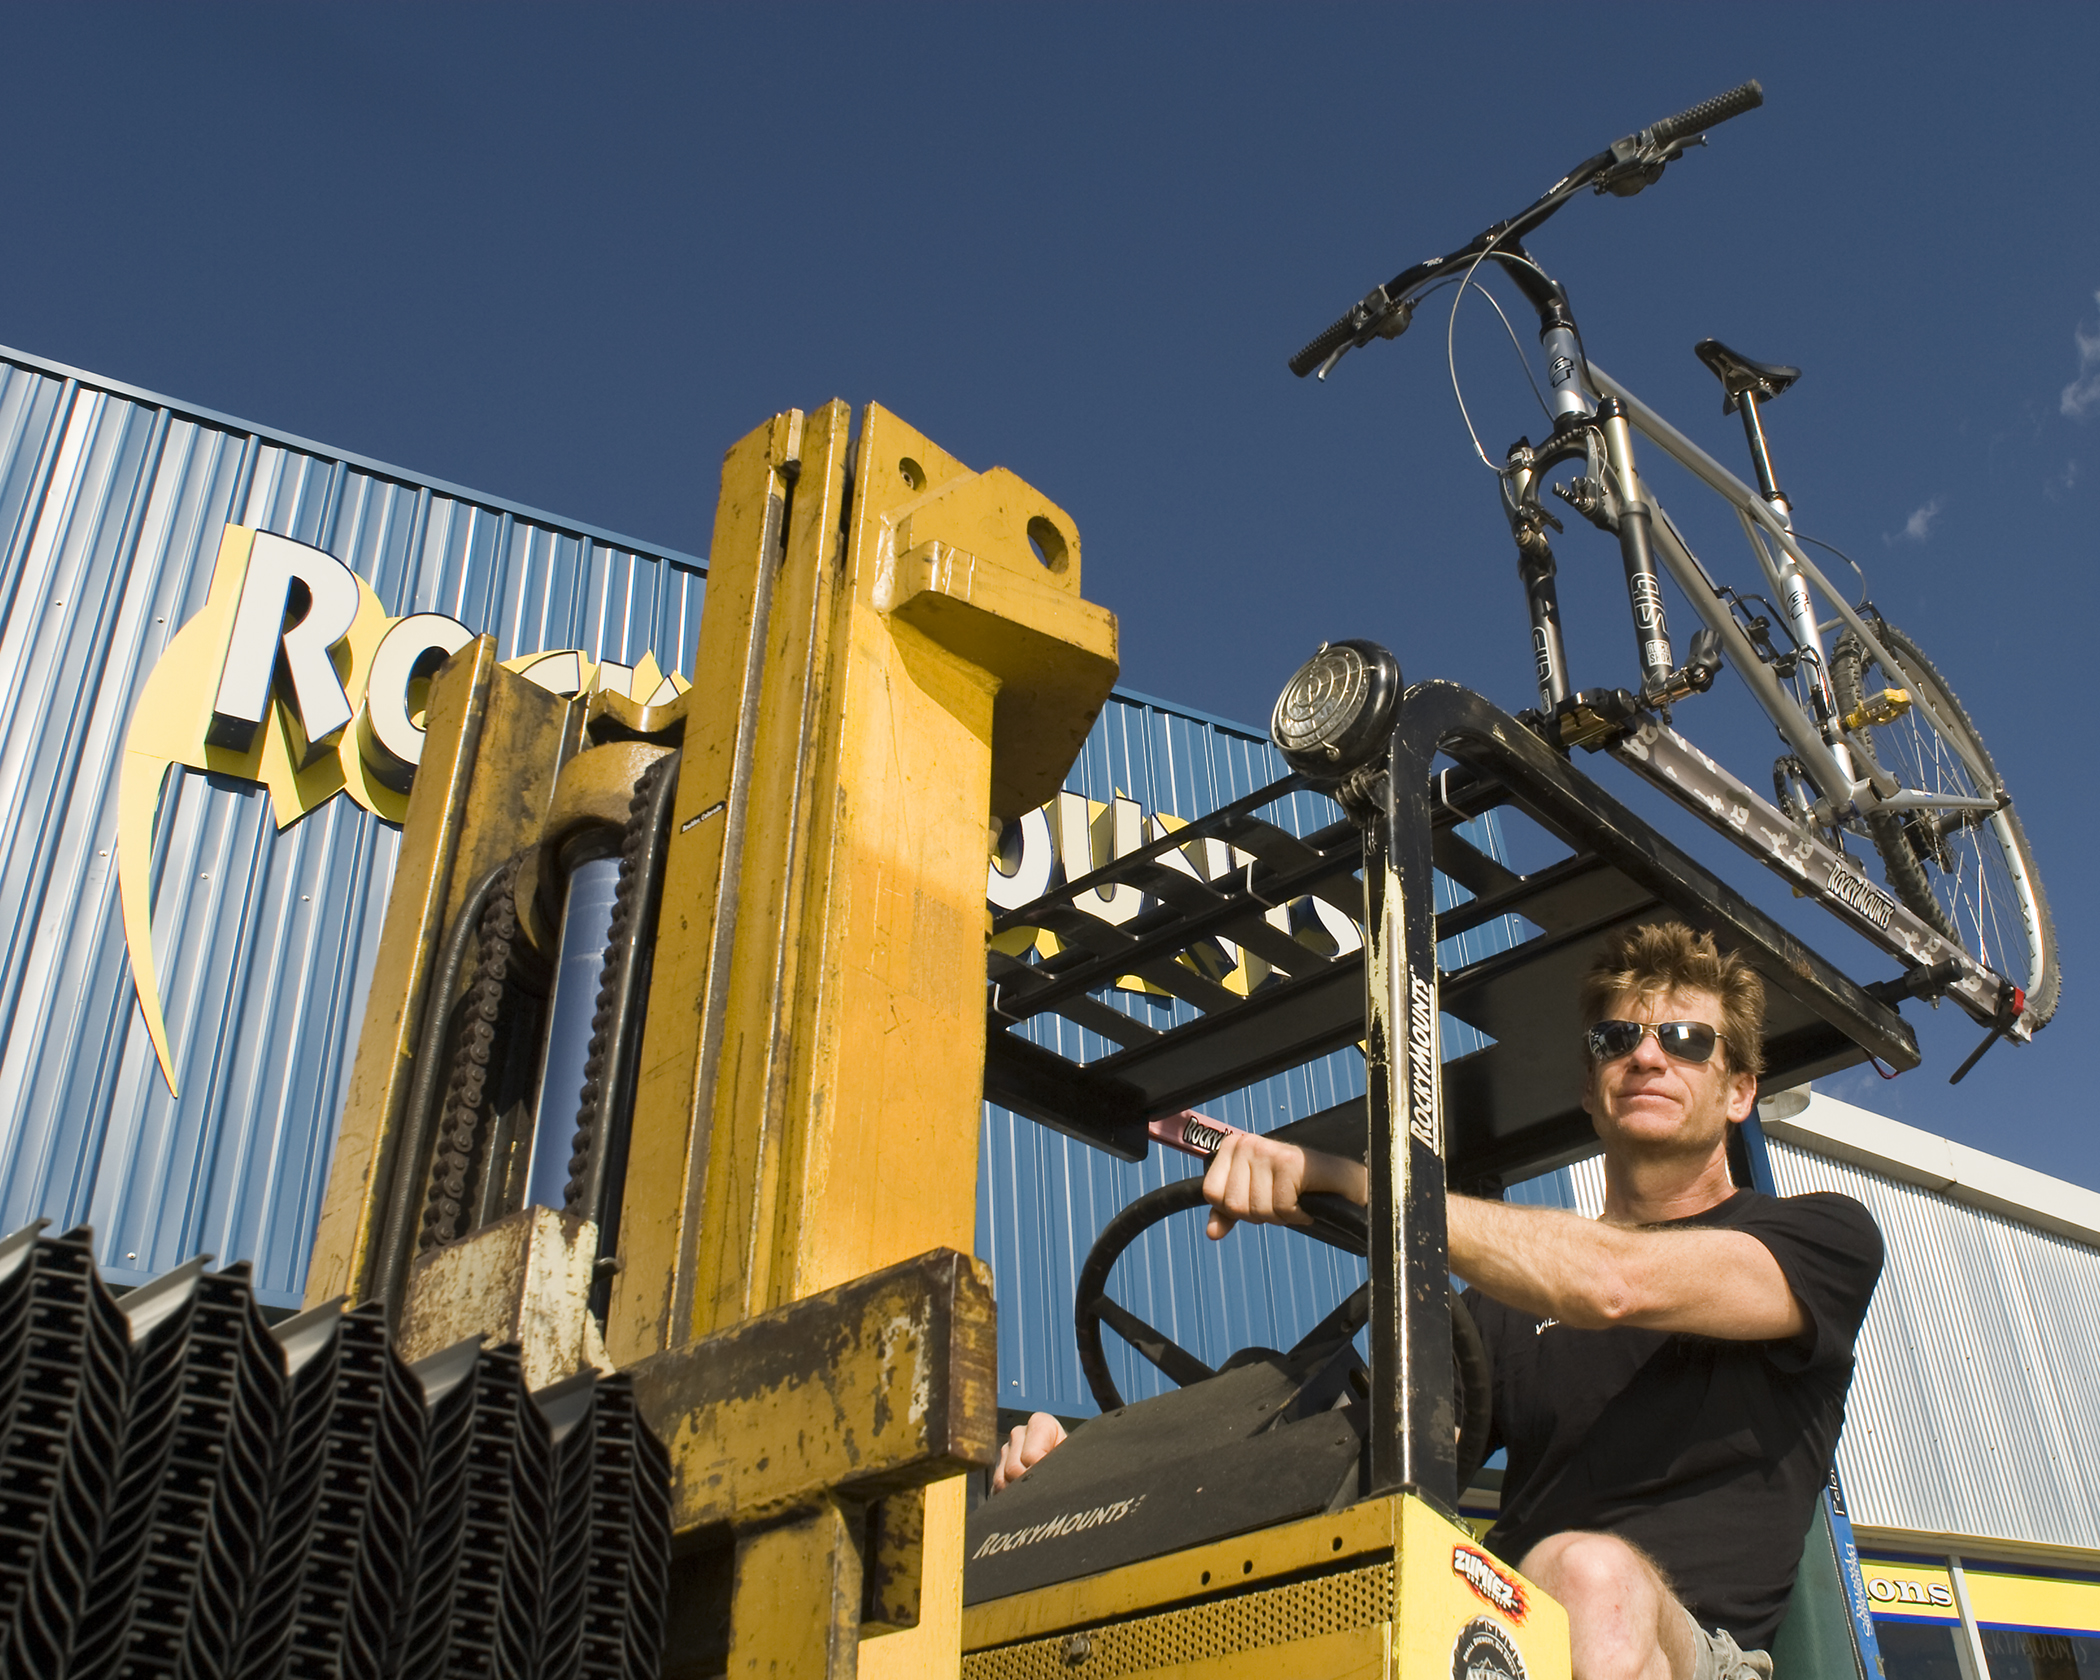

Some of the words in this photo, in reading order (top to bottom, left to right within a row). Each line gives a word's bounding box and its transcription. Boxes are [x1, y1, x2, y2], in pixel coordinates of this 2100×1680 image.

[1827, 860, 1895, 930] ROCKYMOUNTS
[1408, 974, 1433, 1150] ROCKYMOUNTS
[972, 1497, 1136, 1560] ROCKYMOUNTS
[1866, 1577, 1953, 1606] ons
